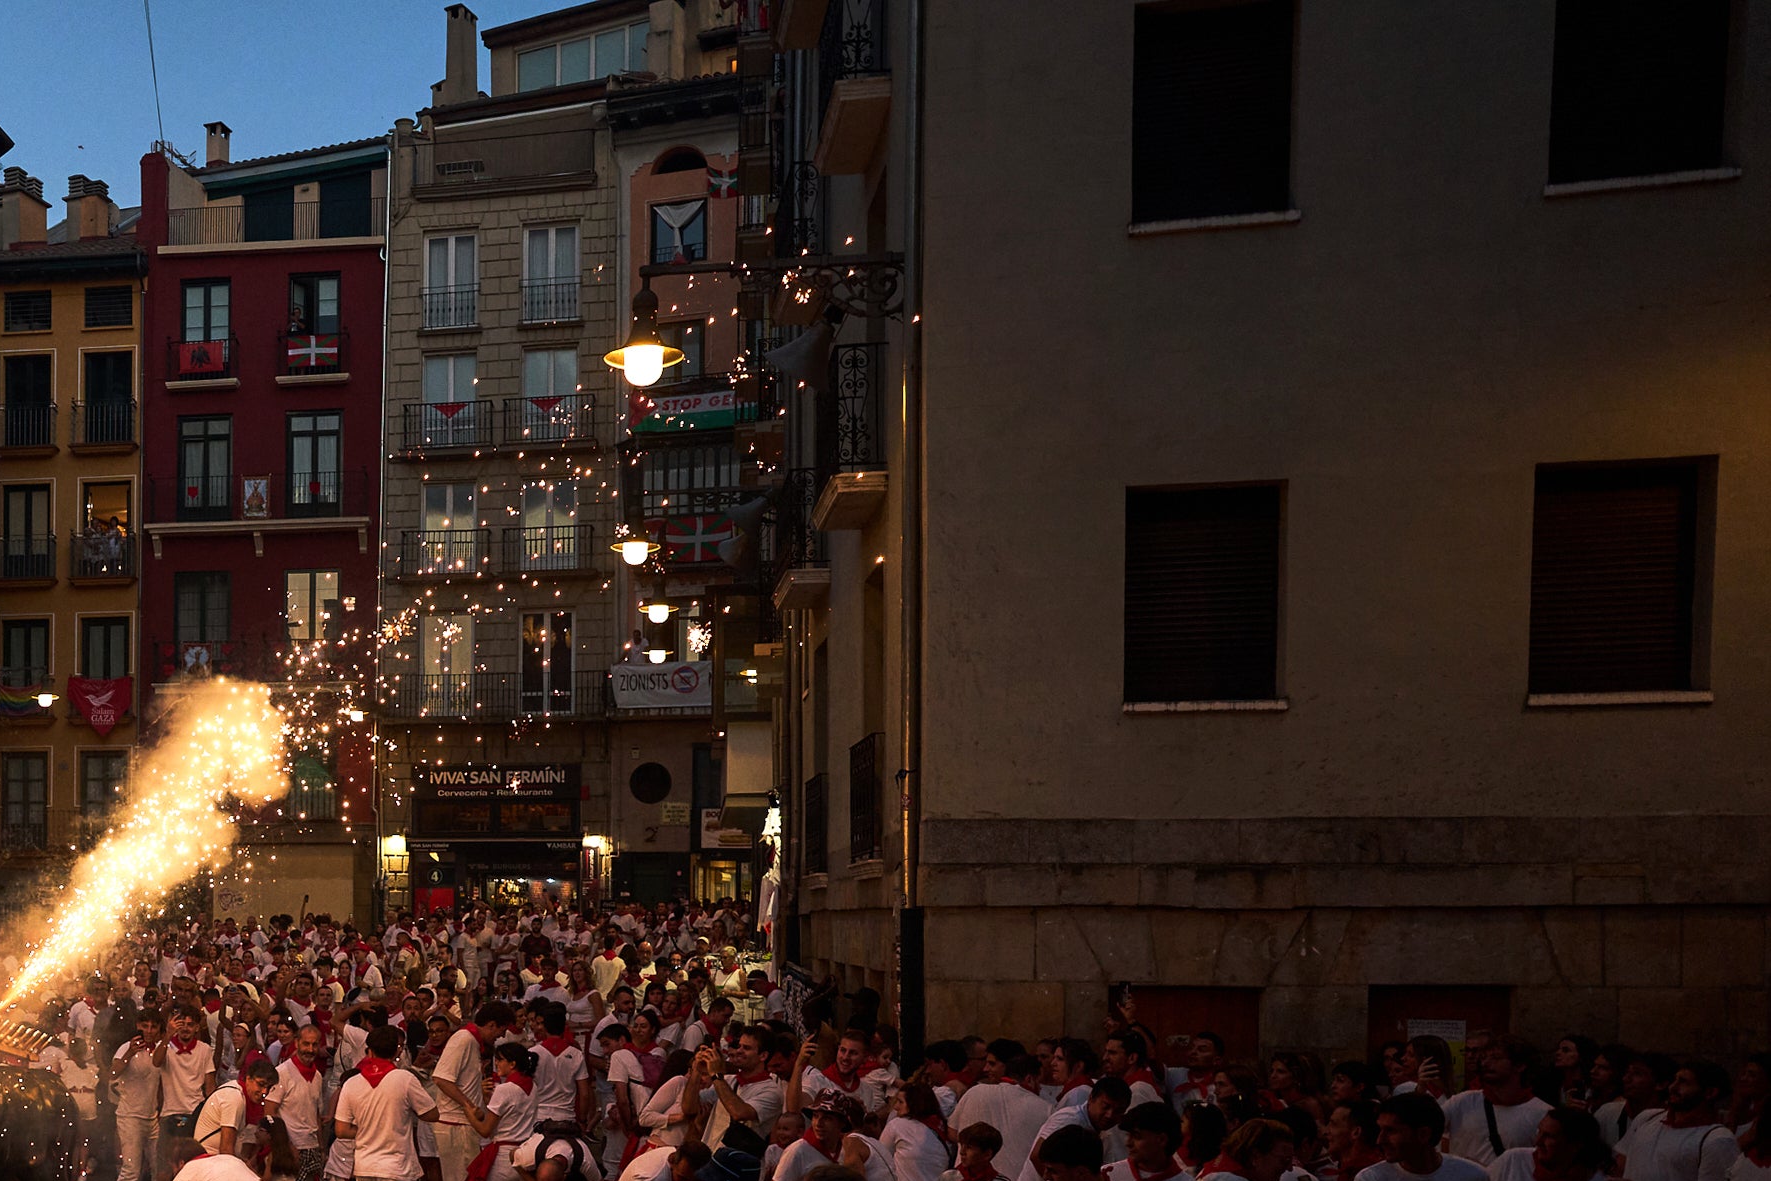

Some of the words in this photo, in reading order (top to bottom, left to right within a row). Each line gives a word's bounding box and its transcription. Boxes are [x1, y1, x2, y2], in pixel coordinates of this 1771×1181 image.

[662, 398, 702, 411] STOP
[620, 673, 669, 692] ZIONISTS
[469, 771, 501, 785] SAN
[496, 788, 554, 797] Restaurante
[431, 871, 439, 882] 4
